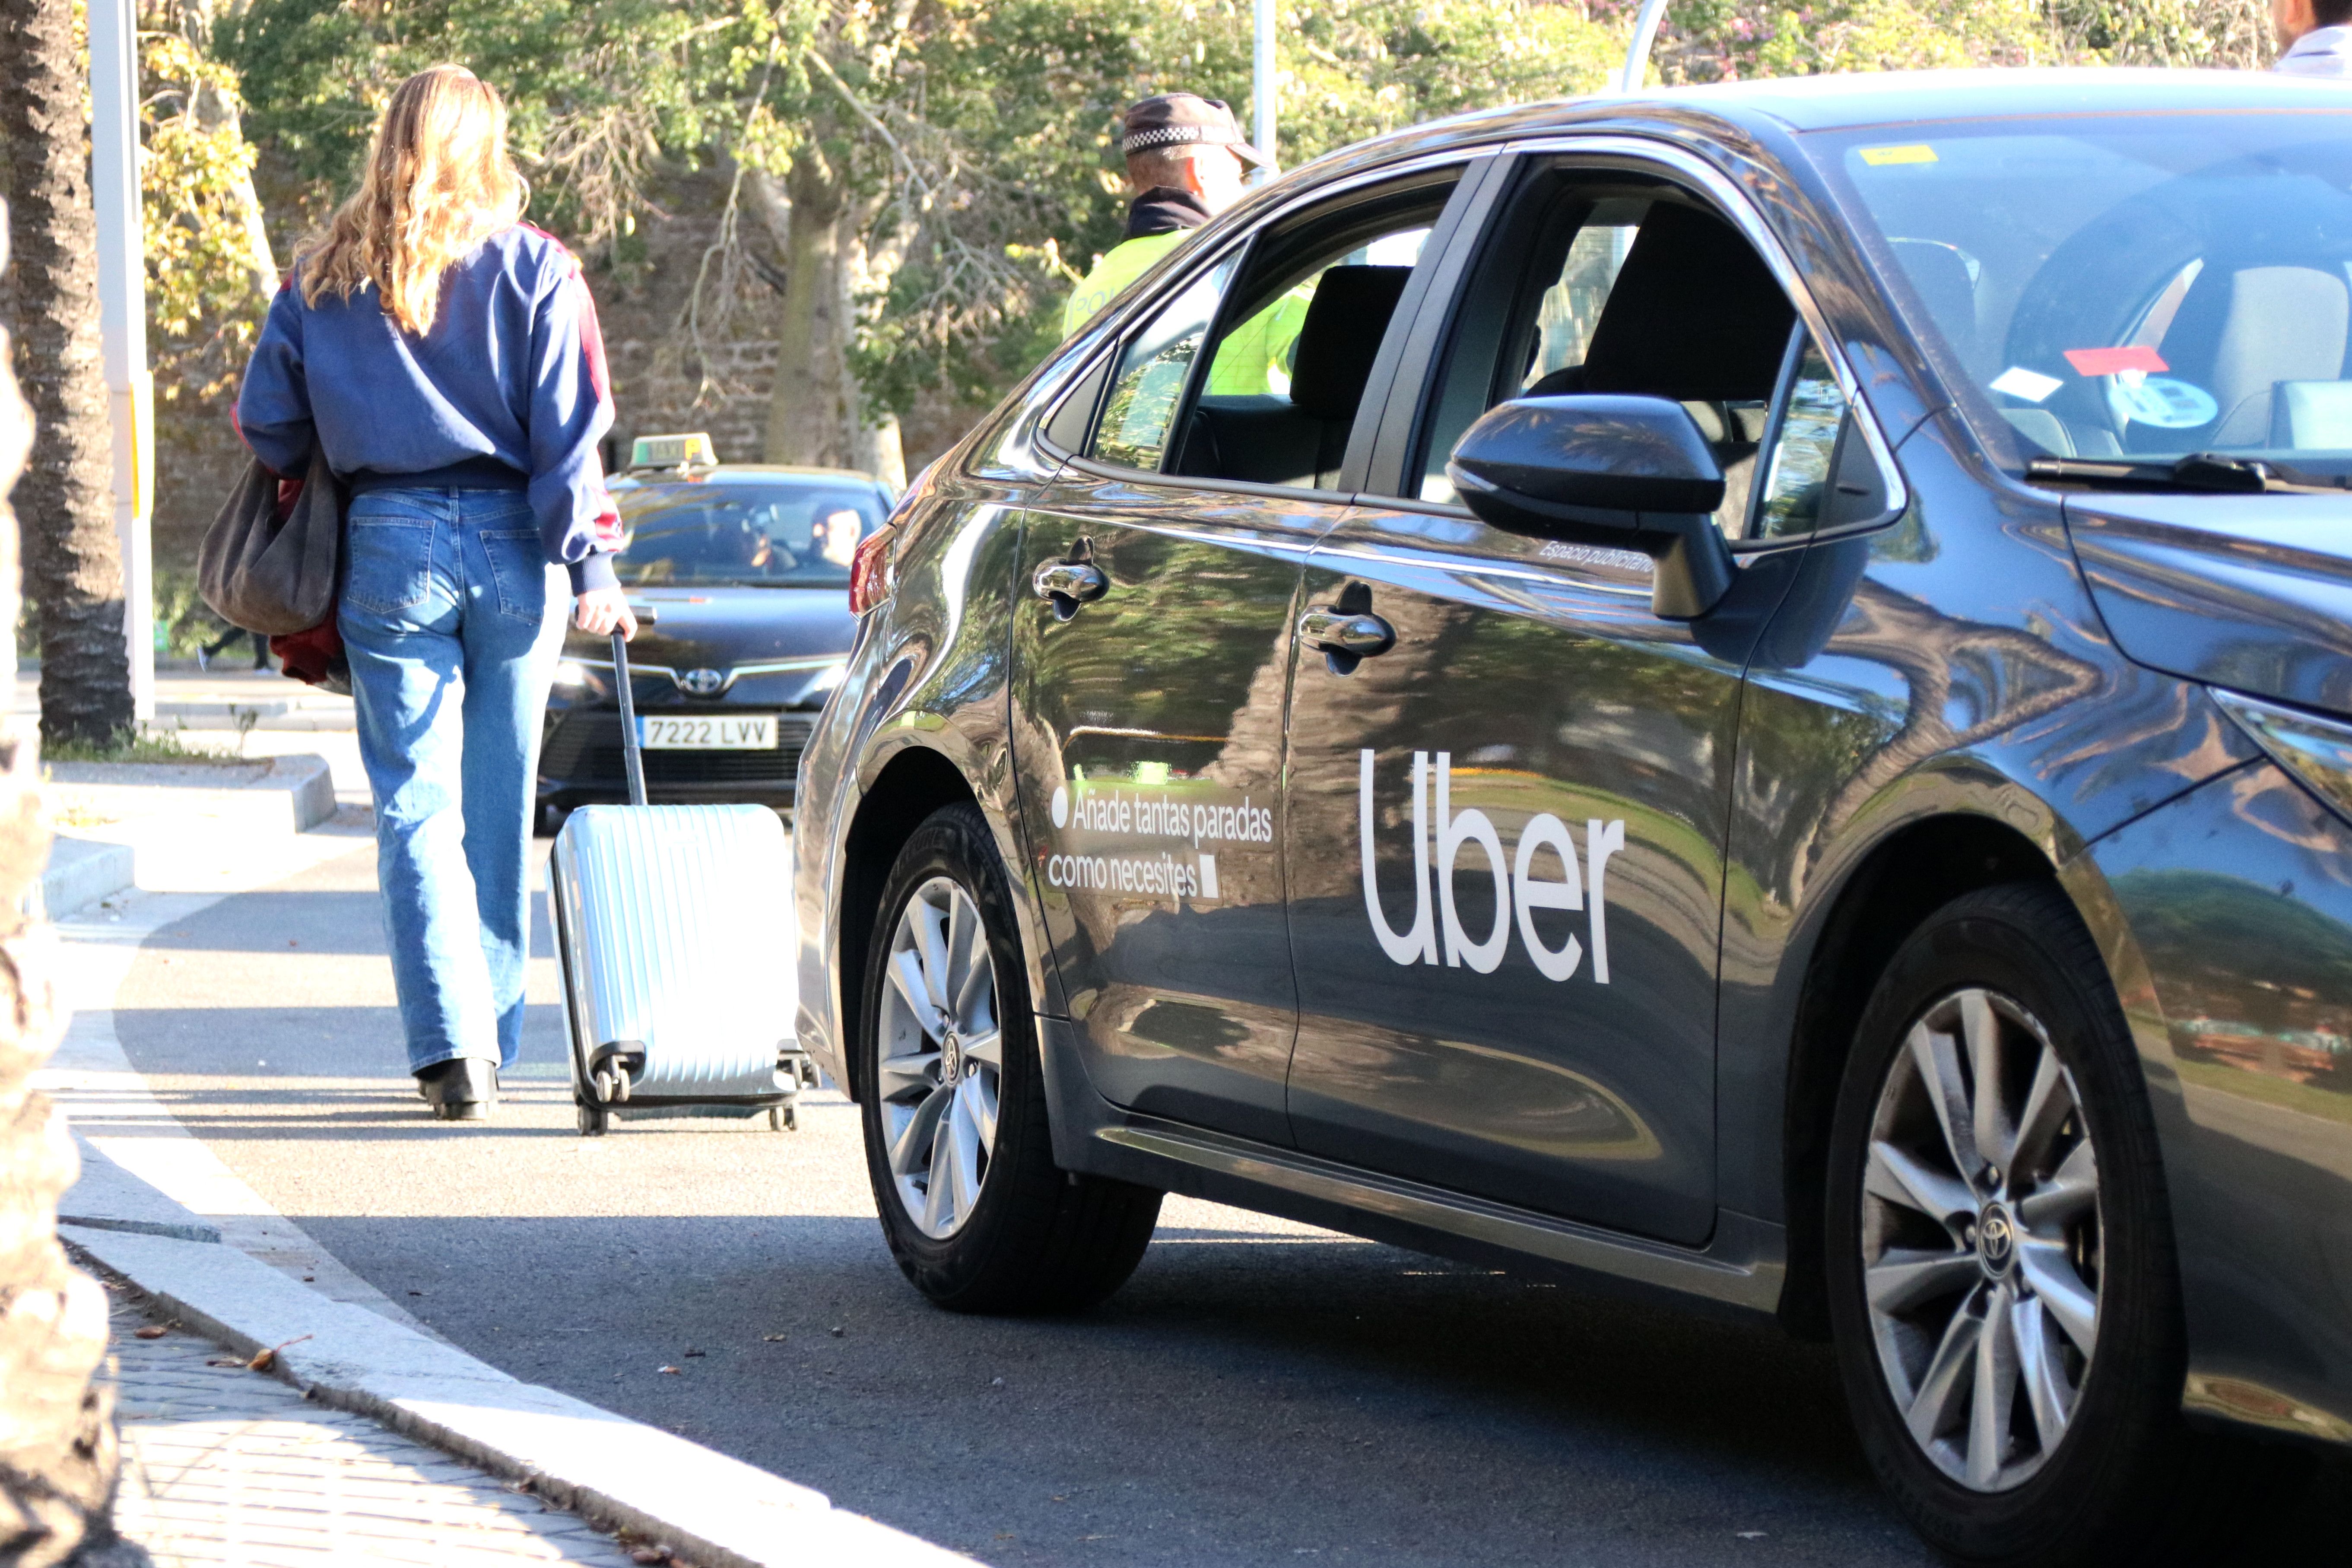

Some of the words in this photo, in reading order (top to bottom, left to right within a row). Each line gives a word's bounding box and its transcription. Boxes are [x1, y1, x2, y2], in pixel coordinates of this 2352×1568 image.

[1539, 540, 1590, 561] Espacio
[651, 721, 712, 744] 7222
[721, 722, 767, 744] LVV
[1073, 788, 1131, 834] Añade
[1134, 792, 1190, 837] tantas
[1193, 796, 1273, 850] paradas
[1048, 854, 1108, 889] como
[1110, 851, 1198, 897] necesites
[1360, 749, 1625, 984] Uber
